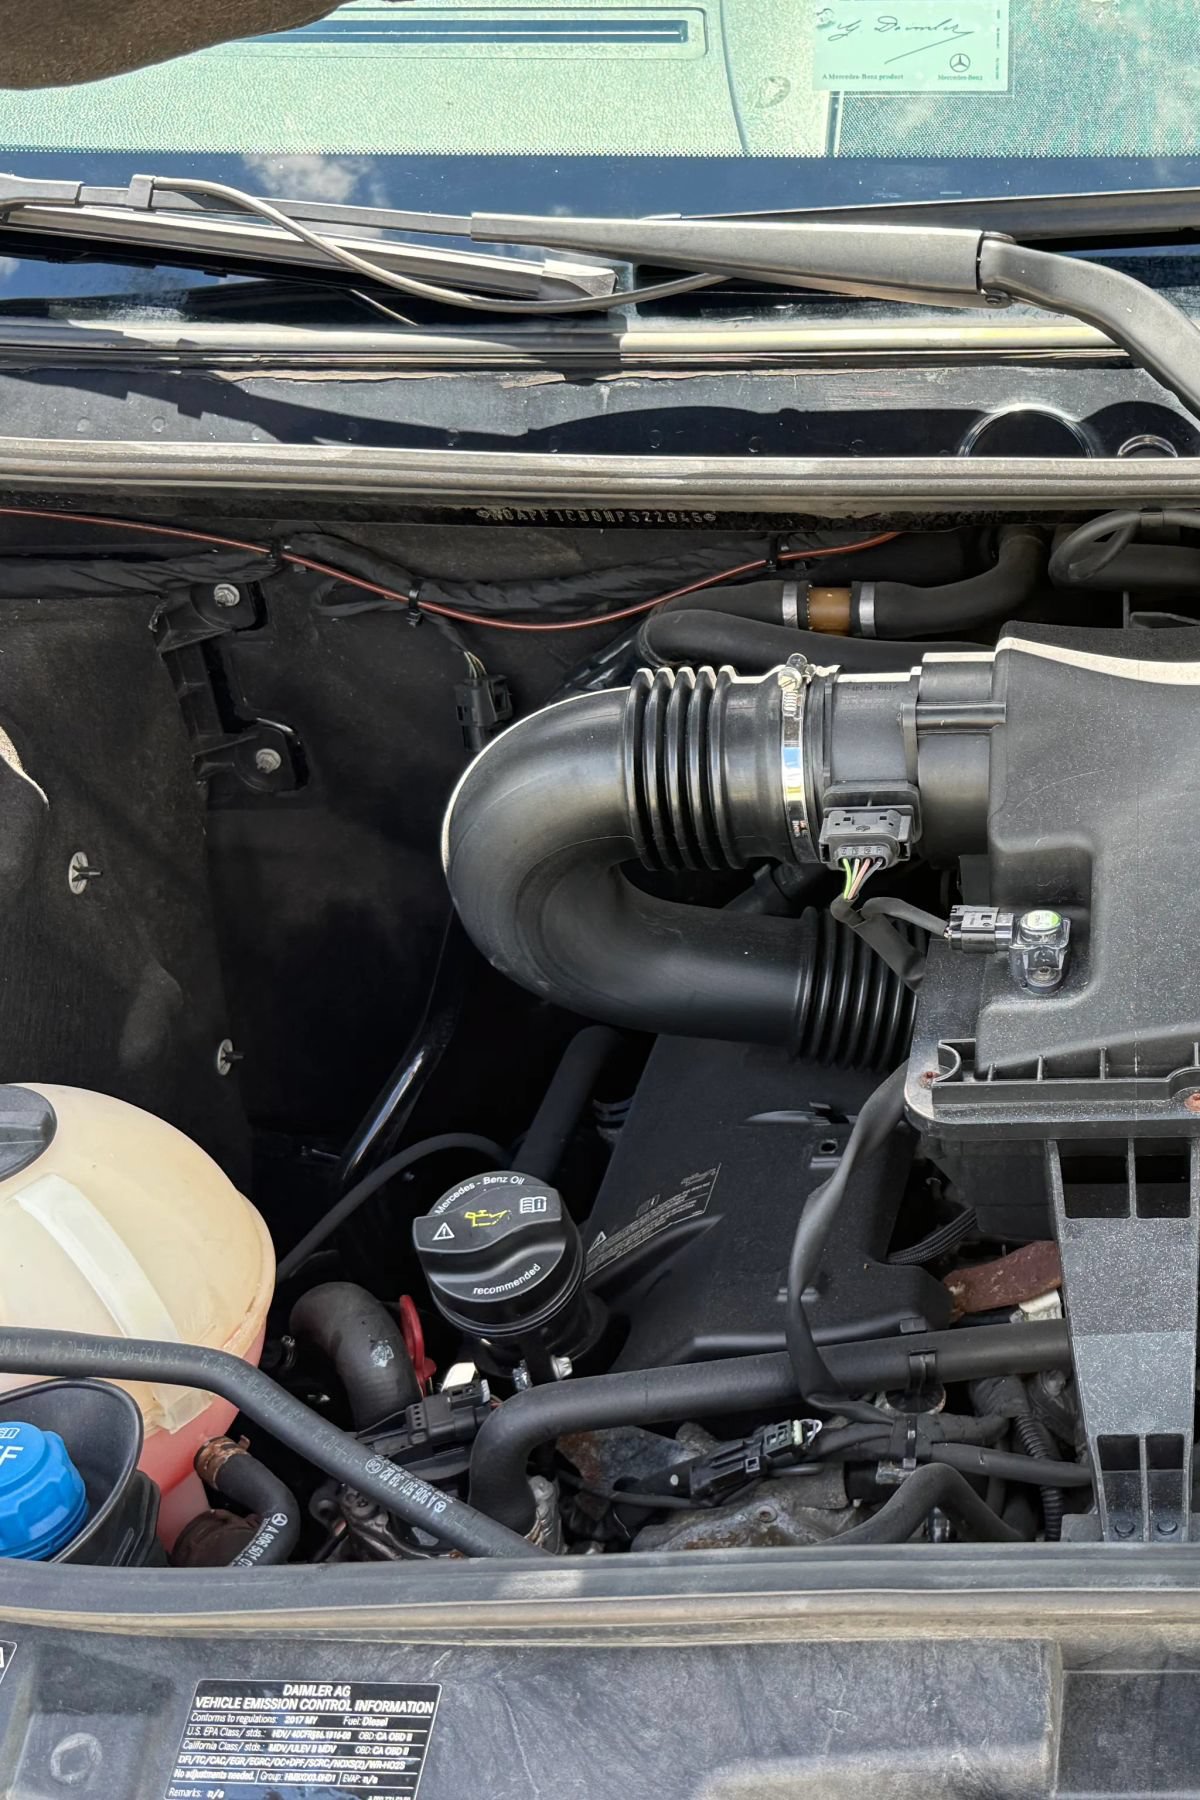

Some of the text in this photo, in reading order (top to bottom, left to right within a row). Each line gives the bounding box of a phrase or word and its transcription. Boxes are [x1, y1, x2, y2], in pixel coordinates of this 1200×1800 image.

[829, 73, 877, 81] Mercedes-Benz
[434, 1182, 475, 1214] Mercedes
[483, 1175, 508, 1185] Benz
[510, 1175, 525, 1185] Oil
[473, 1263, 541, 1295] recommended
[379, 1467, 395, 1480] 82
[388, 1473, 404, 1487] 38
[400, 1479, 418, 1496] 501
[412, 1487, 431, 1504] 906
[426, 1494, 439, 1508] A
[265, 1525, 279, 1533] A
[256, 1533, 274, 1547] 906
[245, 1545, 264, 1560] 501
[282, 1684, 351, 1697] DAIMLER AG
[195, 1696, 434, 1713] VEHICLE EMISSION CONTROL INFORMATION
[190, 1713, 318, 1725] Conforms to regulations: 2017 MY
[343, 1716, 389, 1726] Fuel: Diesel
[187, 1727, 201, 1736] U.S.
[203, 1727, 218, 1736] EPA
[358, 1731, 413, 1741] OBD: CA OBD II
[182, 1740, 217, 1751] California
[268, 1744, 311, 1754] MDV/ULEV
[318, 1745, 337, 1754] MDV
[355, 1746, 410, 1756] OBD: CA OBD II
[174, 1769, 255, 1780] No adjustments needed.
[260, 1771, 283, 1782] Group:
[343, 1774, 378, 1784] EVAP: n/a
[168, 1786, 224, 1799] Remarks: n/a
